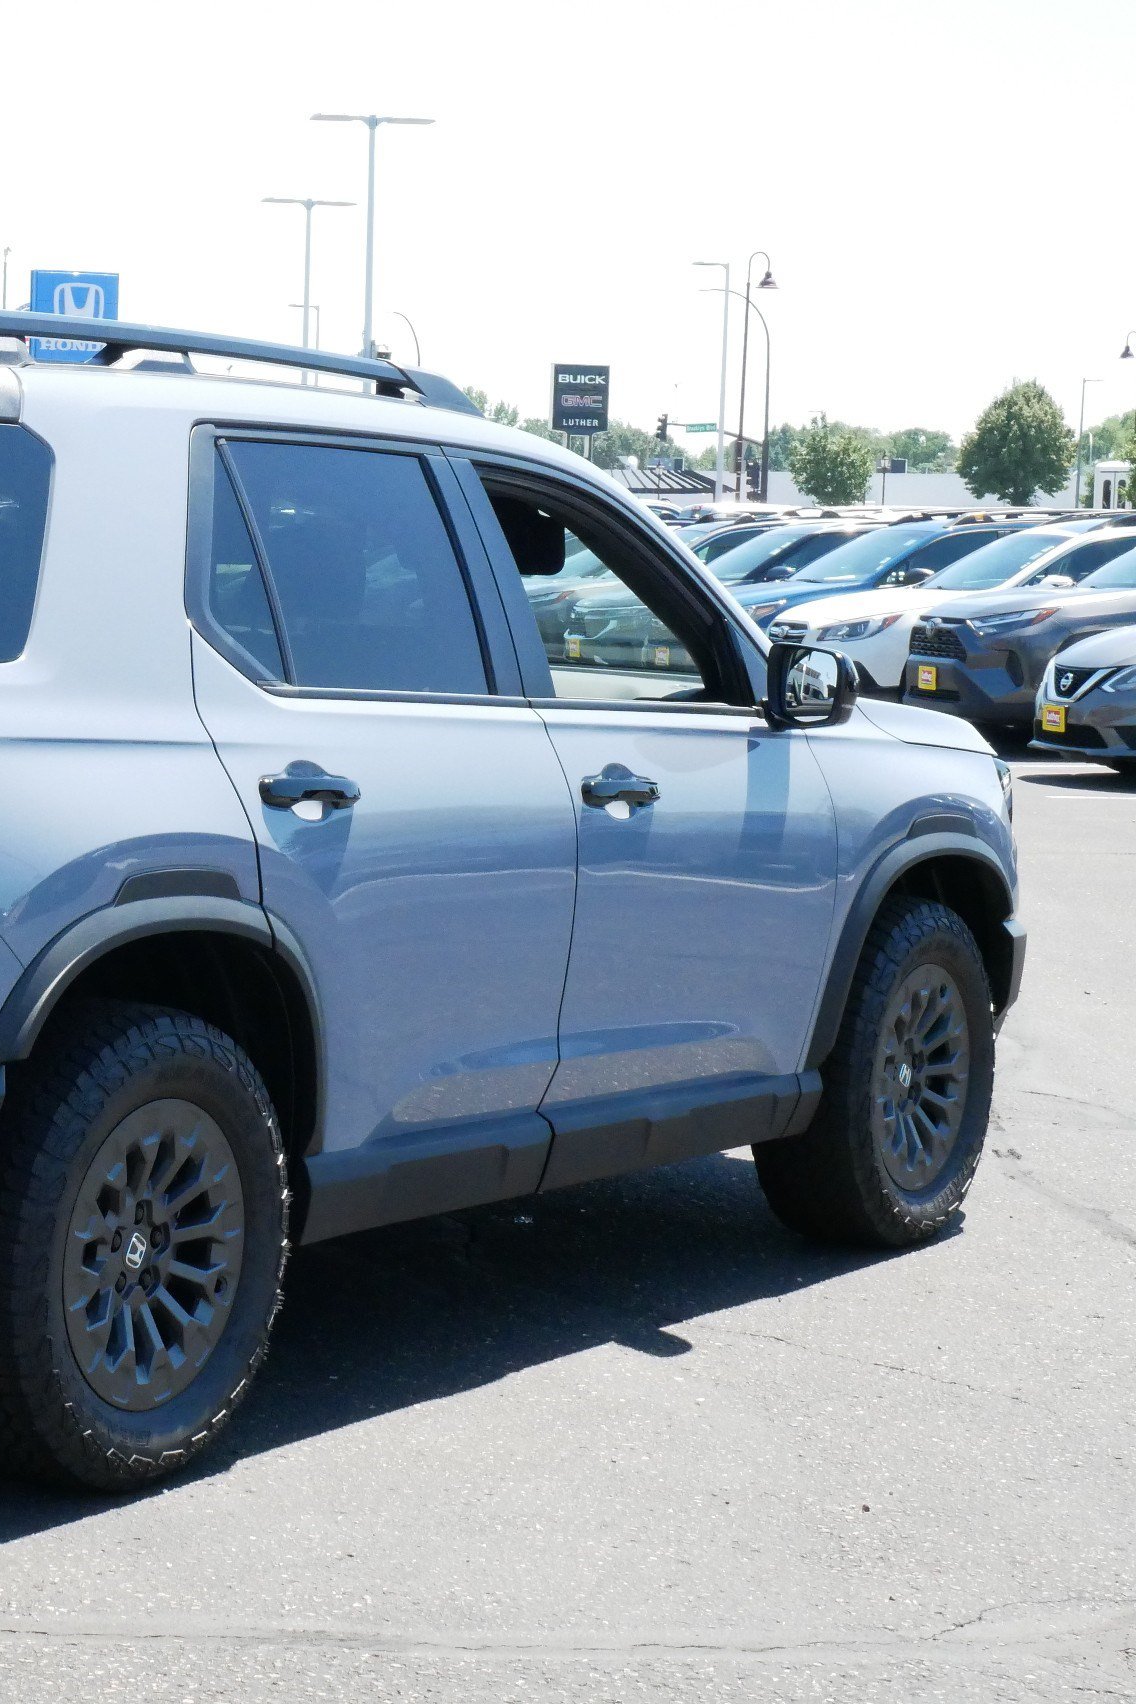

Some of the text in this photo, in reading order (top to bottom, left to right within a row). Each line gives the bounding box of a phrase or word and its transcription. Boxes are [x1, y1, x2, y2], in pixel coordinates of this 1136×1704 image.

[39, 338, 105, 351] HOND
[558, 374, 606, 384] BUICK
[561, 394, 602, 407] GMC
[562, 418, 599, 426] LUTHER
